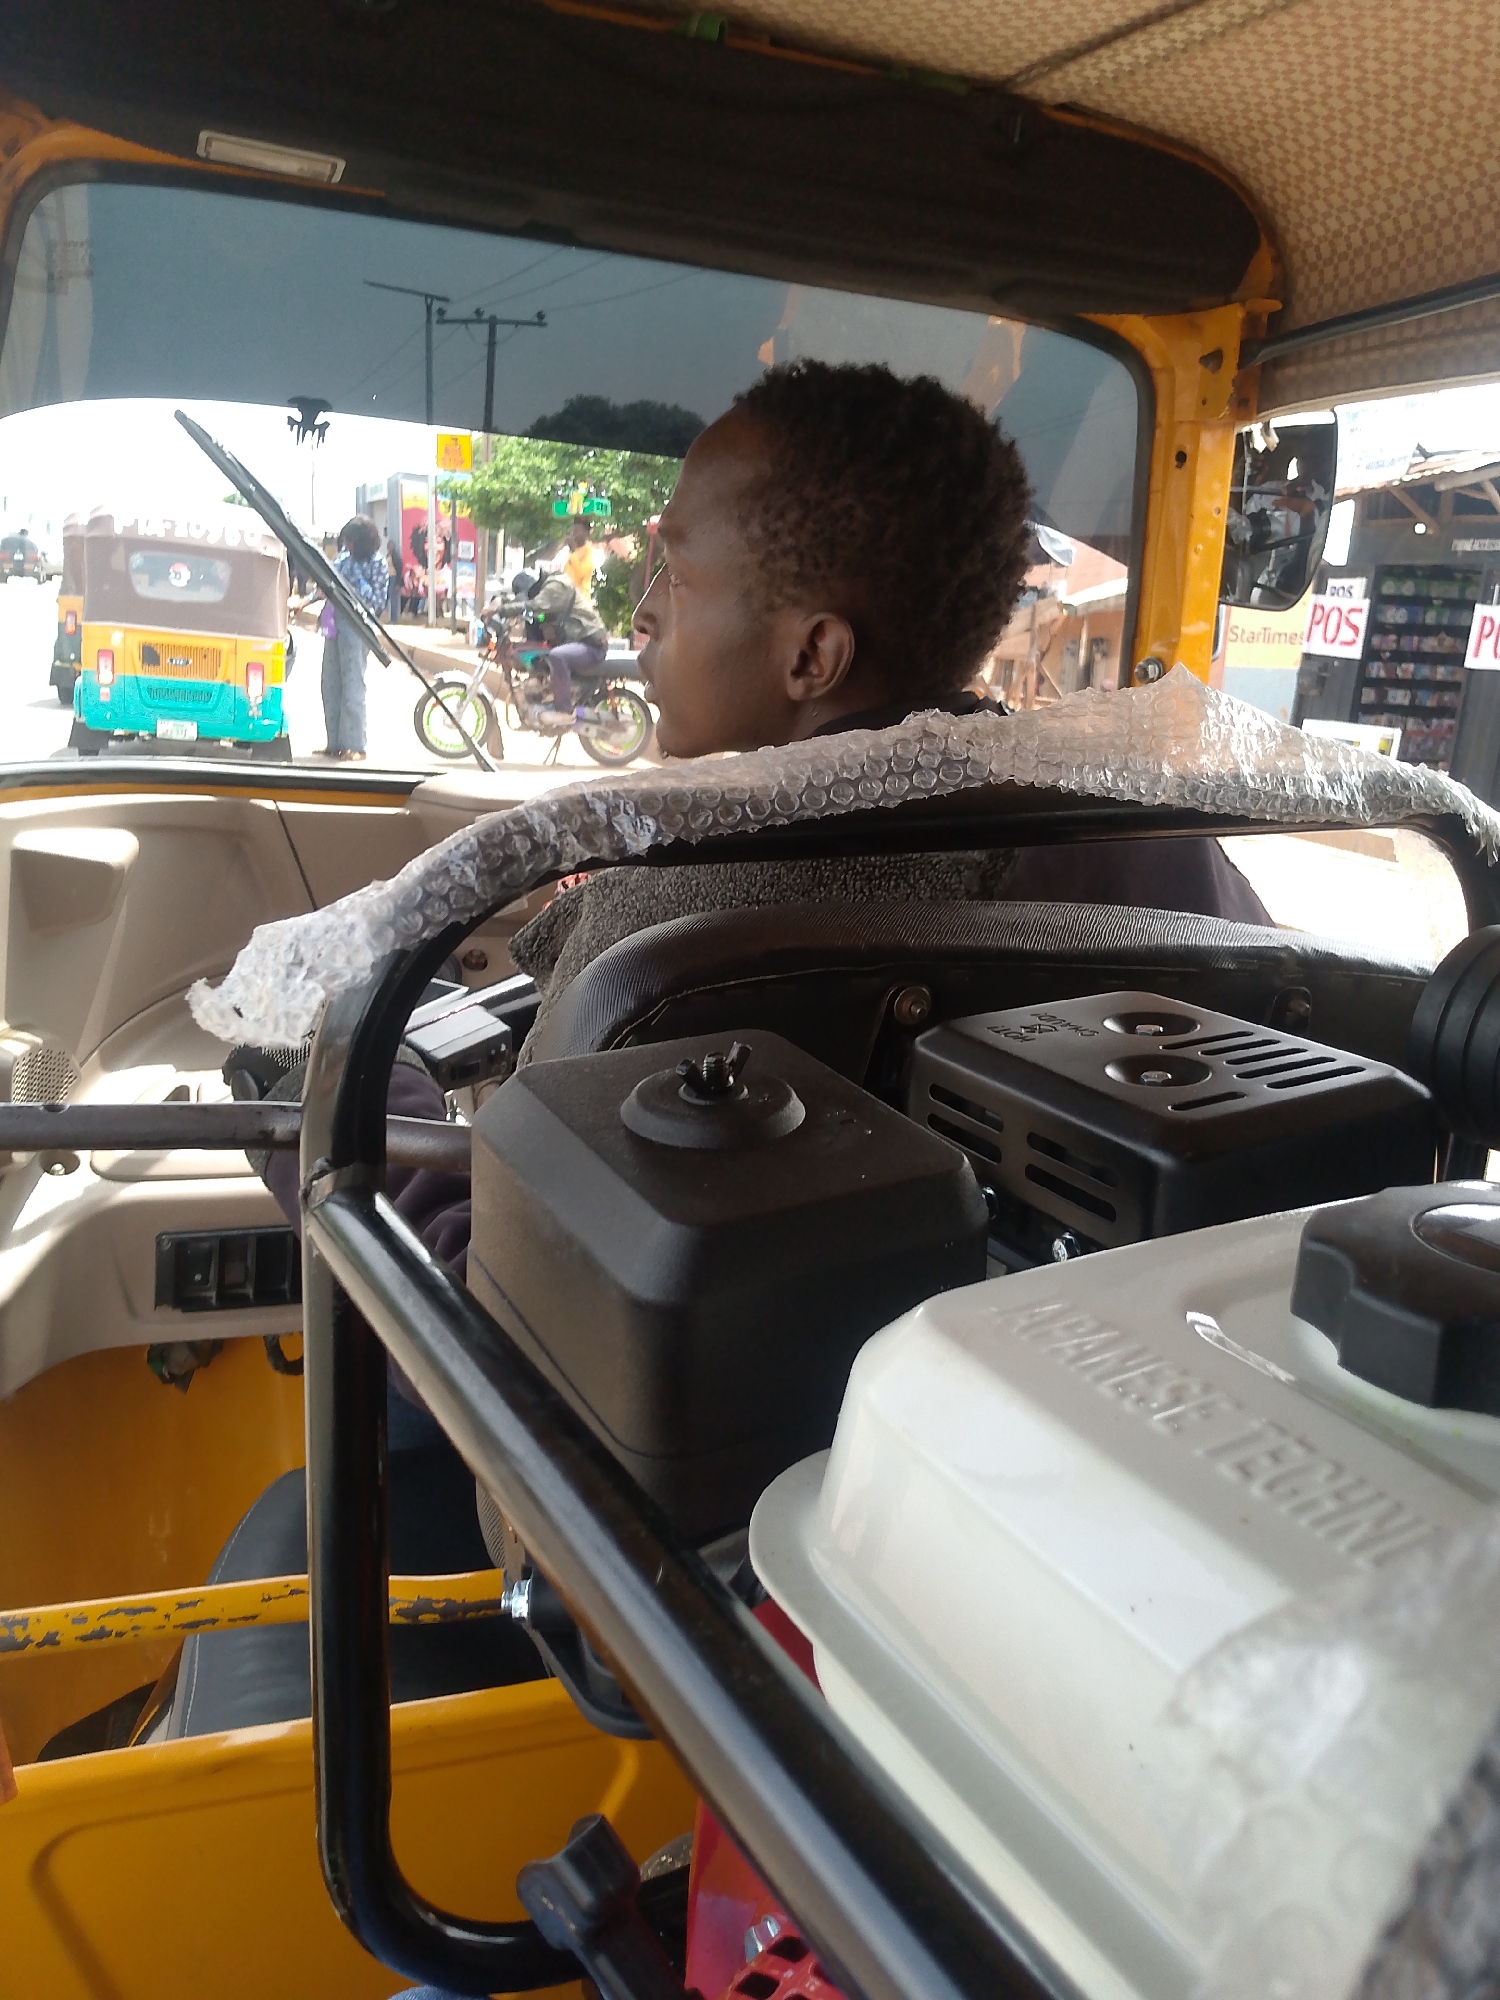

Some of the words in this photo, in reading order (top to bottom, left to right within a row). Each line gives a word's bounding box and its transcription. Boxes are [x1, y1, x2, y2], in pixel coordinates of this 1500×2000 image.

[1329, 585, 1354, 598] POS
[1228, 625, 1305, 646] StarTimes
[1307, 603, 1363, 647] POS
[989, 1298, 1237, 1434] JAPANESE
